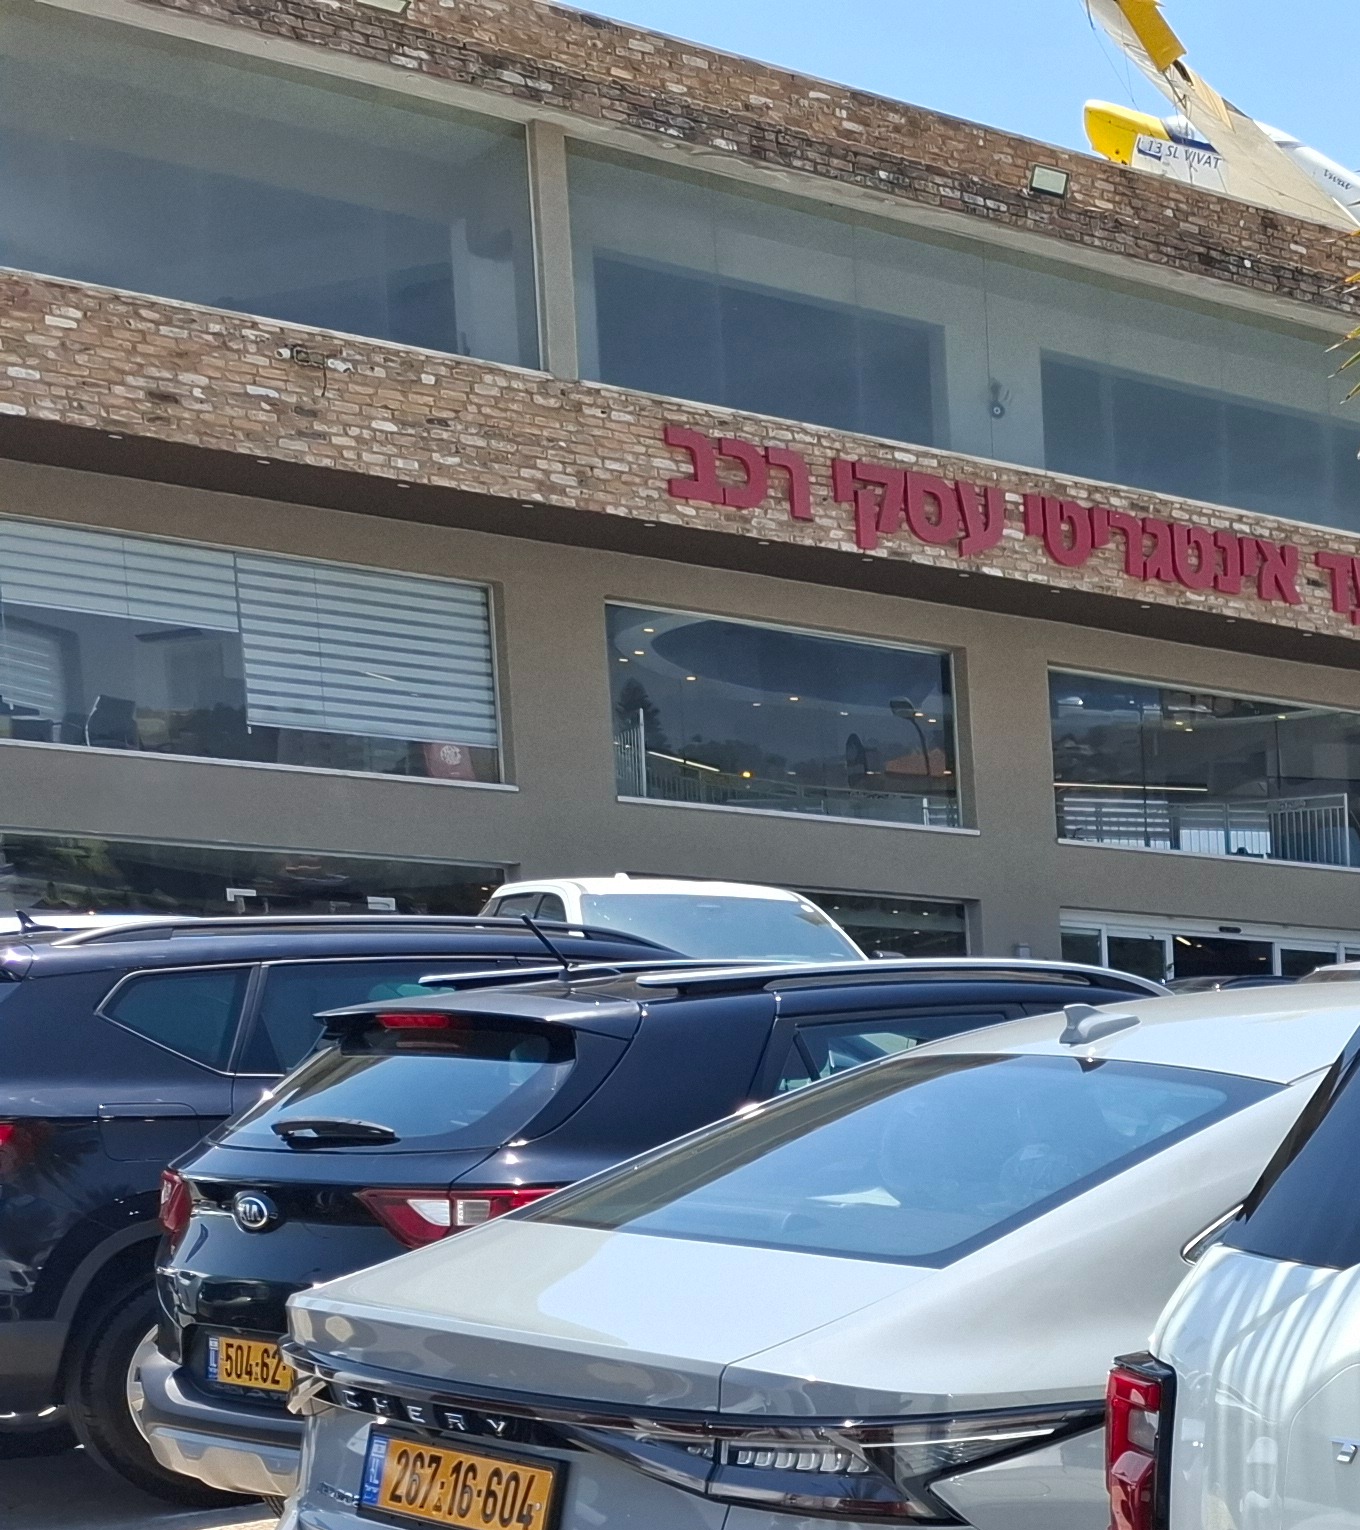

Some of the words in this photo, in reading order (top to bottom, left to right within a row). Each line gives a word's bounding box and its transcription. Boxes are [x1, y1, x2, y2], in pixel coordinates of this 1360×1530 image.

[1166, 145, 1179, 159] SL
[1184, 148, 1223, 169] VIVAT
[664, 423, 814, 522] רכב
[831, 457, 1005, 558] עסקי
[1022, 493, 1302, 605] אינטגריטי
[238, 1203, 262, 1221] KIA
[342, 1389, 509, 1437] CHERY
